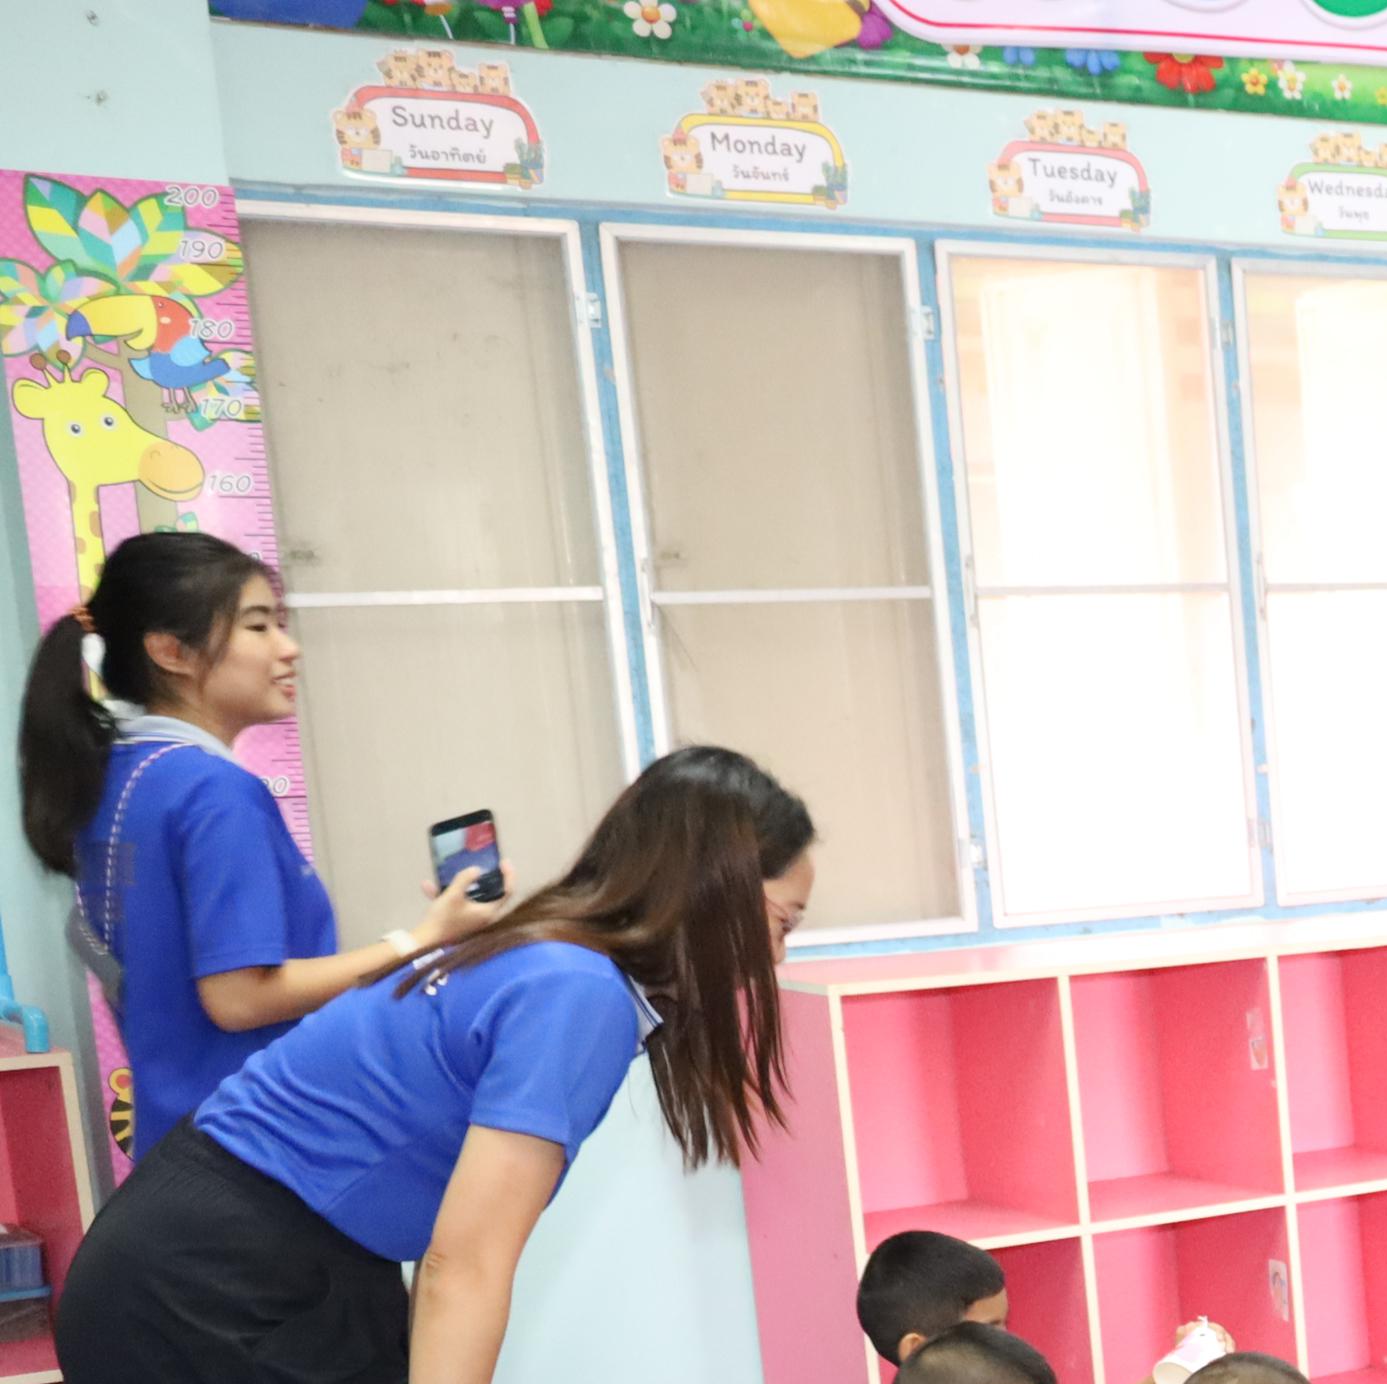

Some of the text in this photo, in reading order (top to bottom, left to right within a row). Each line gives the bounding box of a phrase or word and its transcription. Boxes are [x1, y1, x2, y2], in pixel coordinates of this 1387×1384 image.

[391, 105, 494, 138] Sunday
[711, 131, 807, 161] Monday
[1028, 157, 1118, 189] Tuesday
[166, 186, 218, 206] 200
[180, 239, 224, 260] 190
[190, 319, 233, 339] 180
[200, 398, 243, 418] 170
[209, 474, 252, 493] 160
